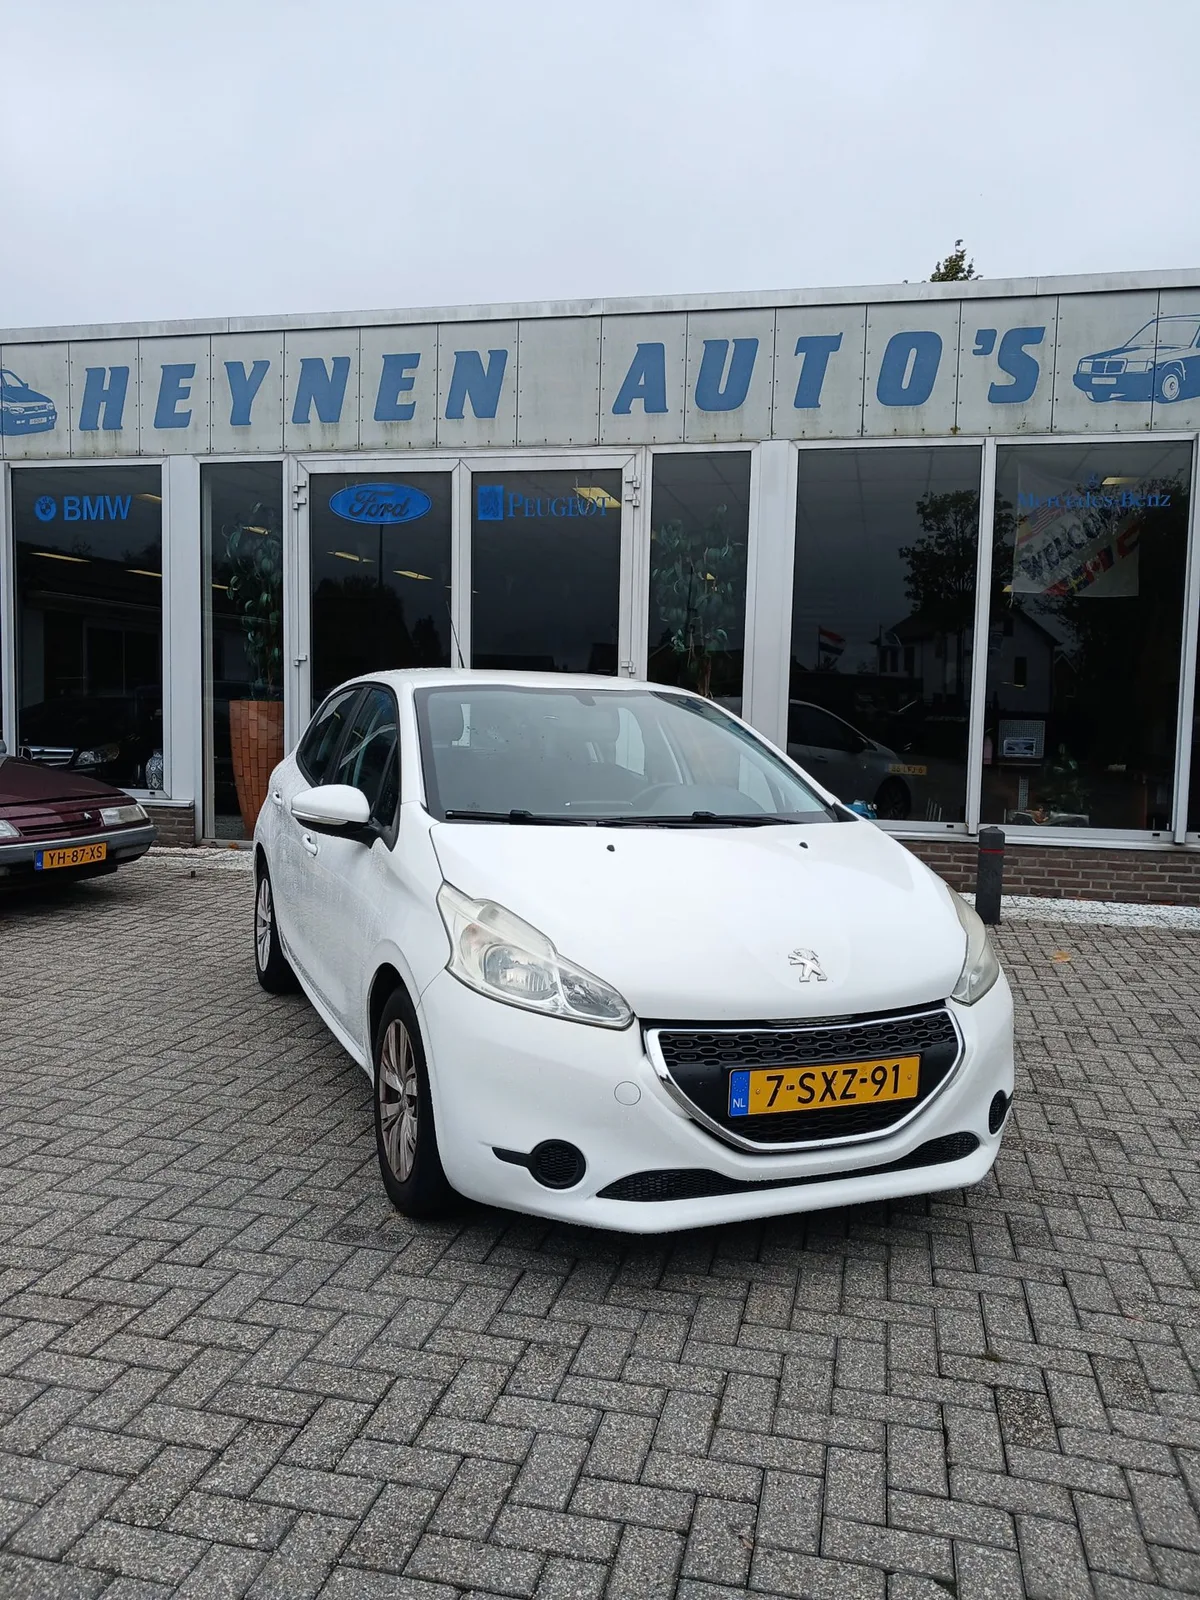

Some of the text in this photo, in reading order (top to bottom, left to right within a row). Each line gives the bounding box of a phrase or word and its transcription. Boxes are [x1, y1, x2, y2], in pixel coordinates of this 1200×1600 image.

[79, 326, 1046, 431] HEYNEN AUTO'S
[63, 495, 132, 520] BMW
[349, 489, 411, 518] Ford
[508, 492, 613, 518] PEUGEOT
[49, 845, 103, 866] YH-87-XS
[732, 1064, 900, 1108] NL 7-SXZ-91
